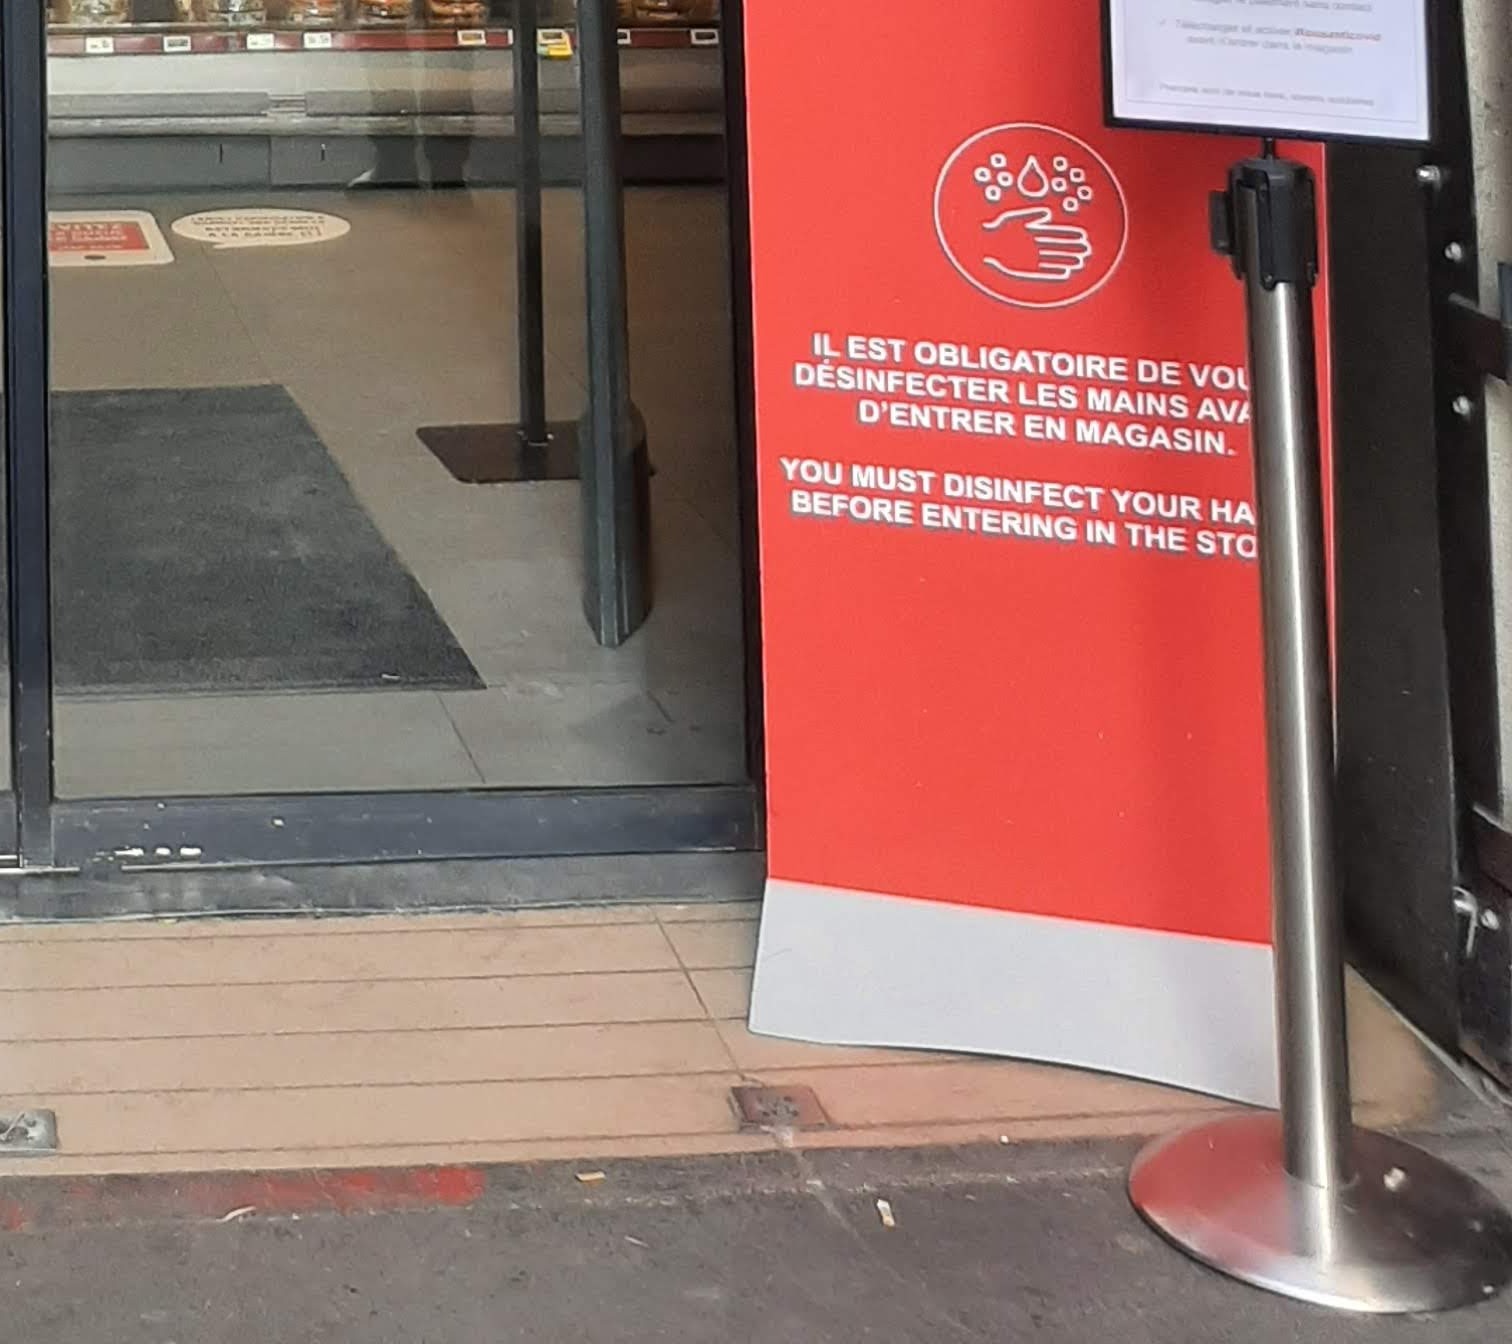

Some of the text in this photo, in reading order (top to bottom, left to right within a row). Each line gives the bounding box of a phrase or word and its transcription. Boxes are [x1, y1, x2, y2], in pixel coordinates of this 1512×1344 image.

[794, 358, 1010, 404] DÉSINFECTER
[1018, 382, 1078, 410] LES
[1086, 387, 1189, 420] MAINS
[813, 333, 841, 360] IL
[847, 335, 906, 365] EST
[913, 340, 1129, 382] OBLIGATOIRE
[1138, 360, 1181, 386] DE
[858, 400, 1237, 456] D'ENTRER EN MAGASIN.
[780, 457, 1255, 525] YOU MUST DISINFECT YOUR HA
[791, 491, 1257, 559] BEFORE ENTERING IN THE STO
